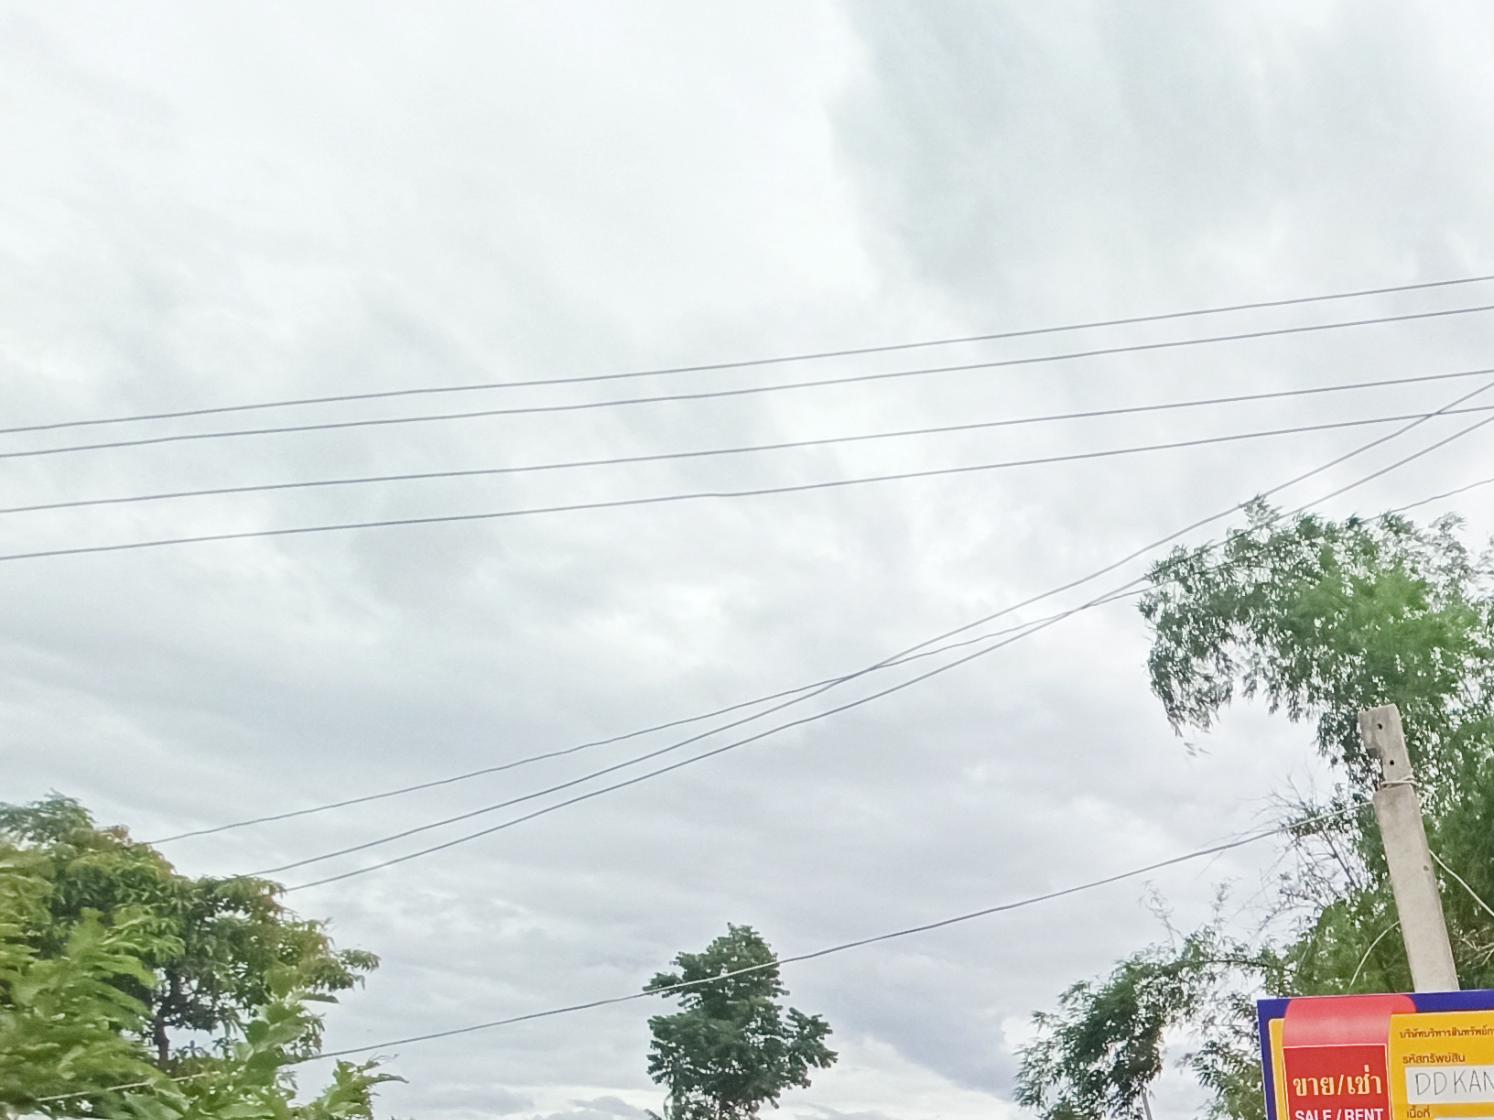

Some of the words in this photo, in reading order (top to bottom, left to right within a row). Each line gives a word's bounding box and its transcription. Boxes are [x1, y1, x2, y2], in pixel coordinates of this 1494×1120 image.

[1402, 1052, 1466, 1065] รหัสทรัพย์สิน
[1293, 1064, 1382, 1096] ขาย/เช่า
